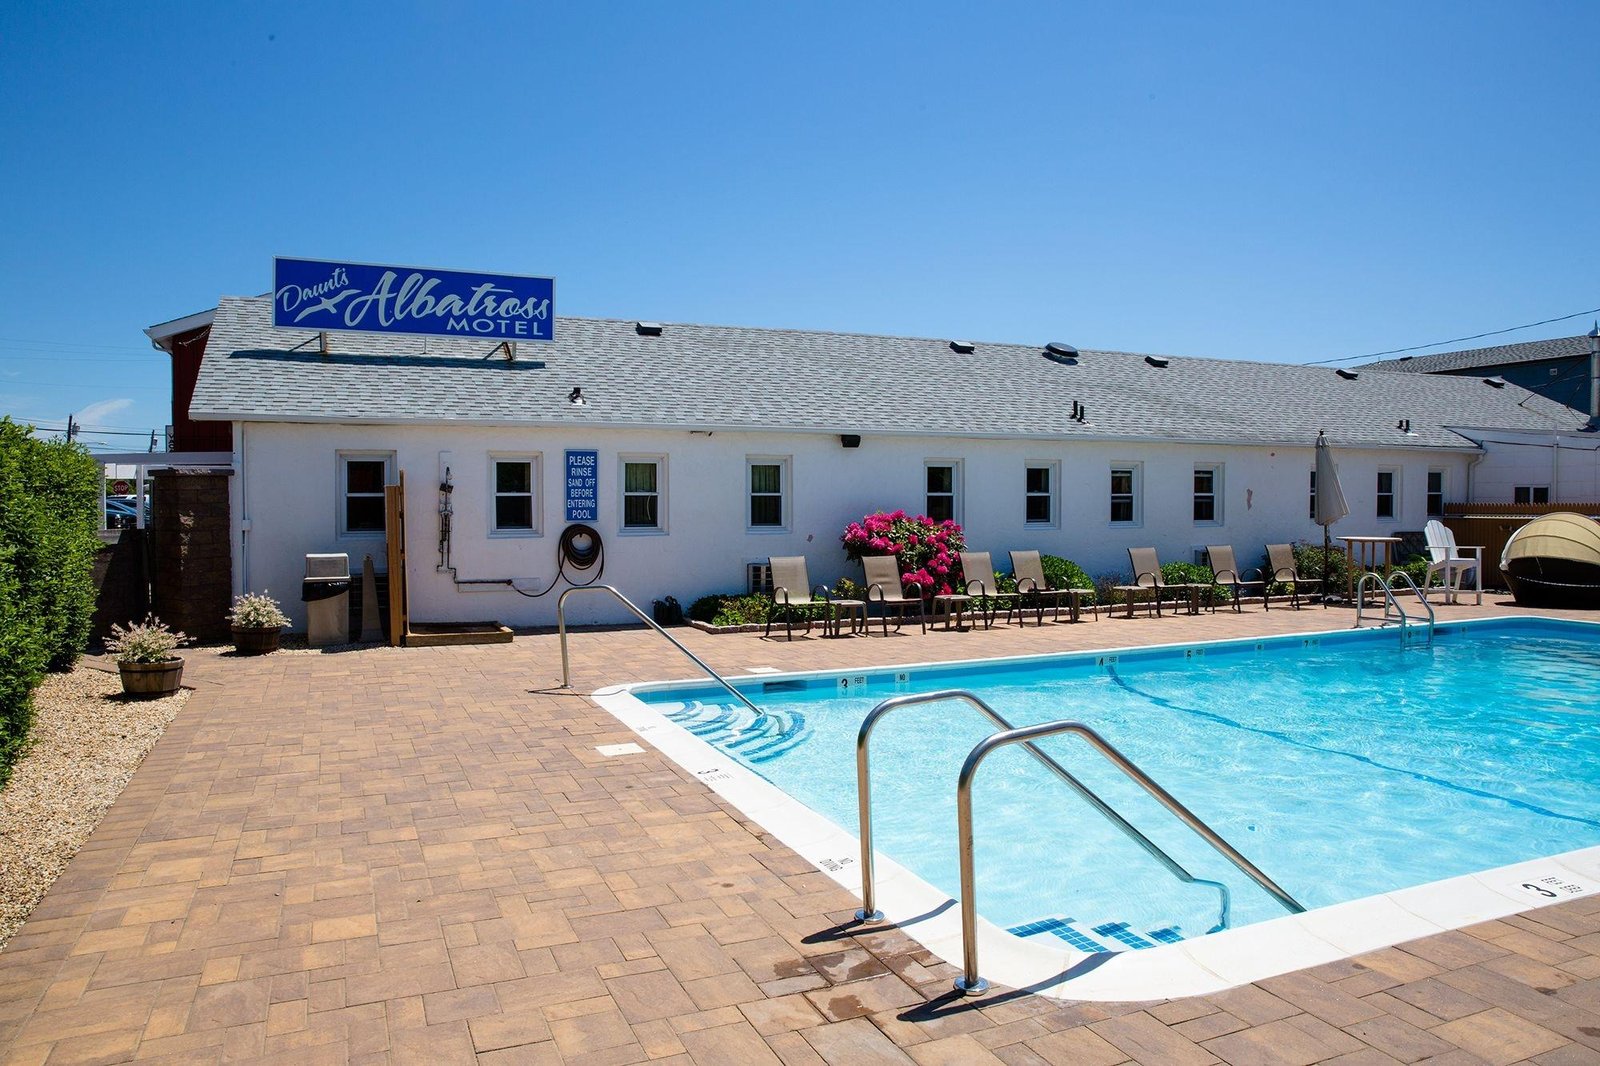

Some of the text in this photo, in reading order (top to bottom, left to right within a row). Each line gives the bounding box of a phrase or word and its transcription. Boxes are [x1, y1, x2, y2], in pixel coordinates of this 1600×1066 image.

[344, 270, 551, 327] Albatross
[446, 317, 544, 336] MOTEL
[569, 456, 595, 465] PLEASE
[571, 467, 592, 476] RINSE
[568, 478, 596, 487] SAND OFF
[570, 489, 593, 497] BEFORE
[567, 499, 595, 507] ENTERING
[572, 510, 591, 518] POOL
[854, 676, 865, 684] FEET
[1522, 883, 1557, 897] 3
